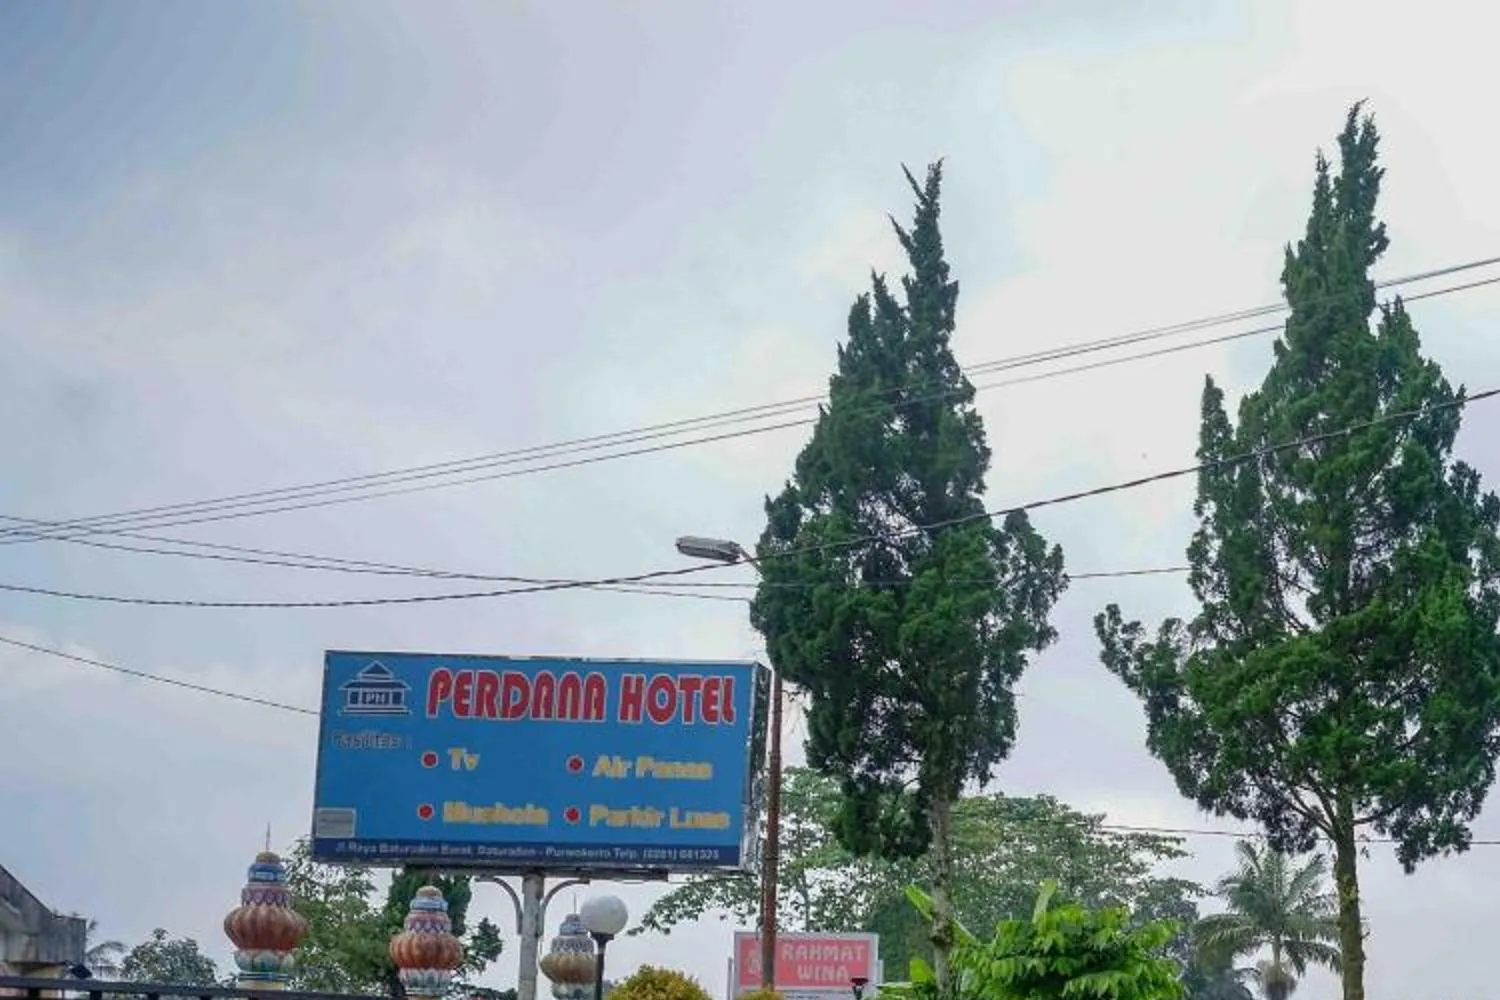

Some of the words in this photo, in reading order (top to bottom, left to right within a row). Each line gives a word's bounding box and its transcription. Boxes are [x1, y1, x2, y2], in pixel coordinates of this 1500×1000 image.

[426, 667, 606, 722] PERDANA
[618, 672, 736, 725] HOTEL
[447, 748, 480, 771] Tv
[592, 755, 632, 779] Air
[590, 804, 665, 828] Parkir
